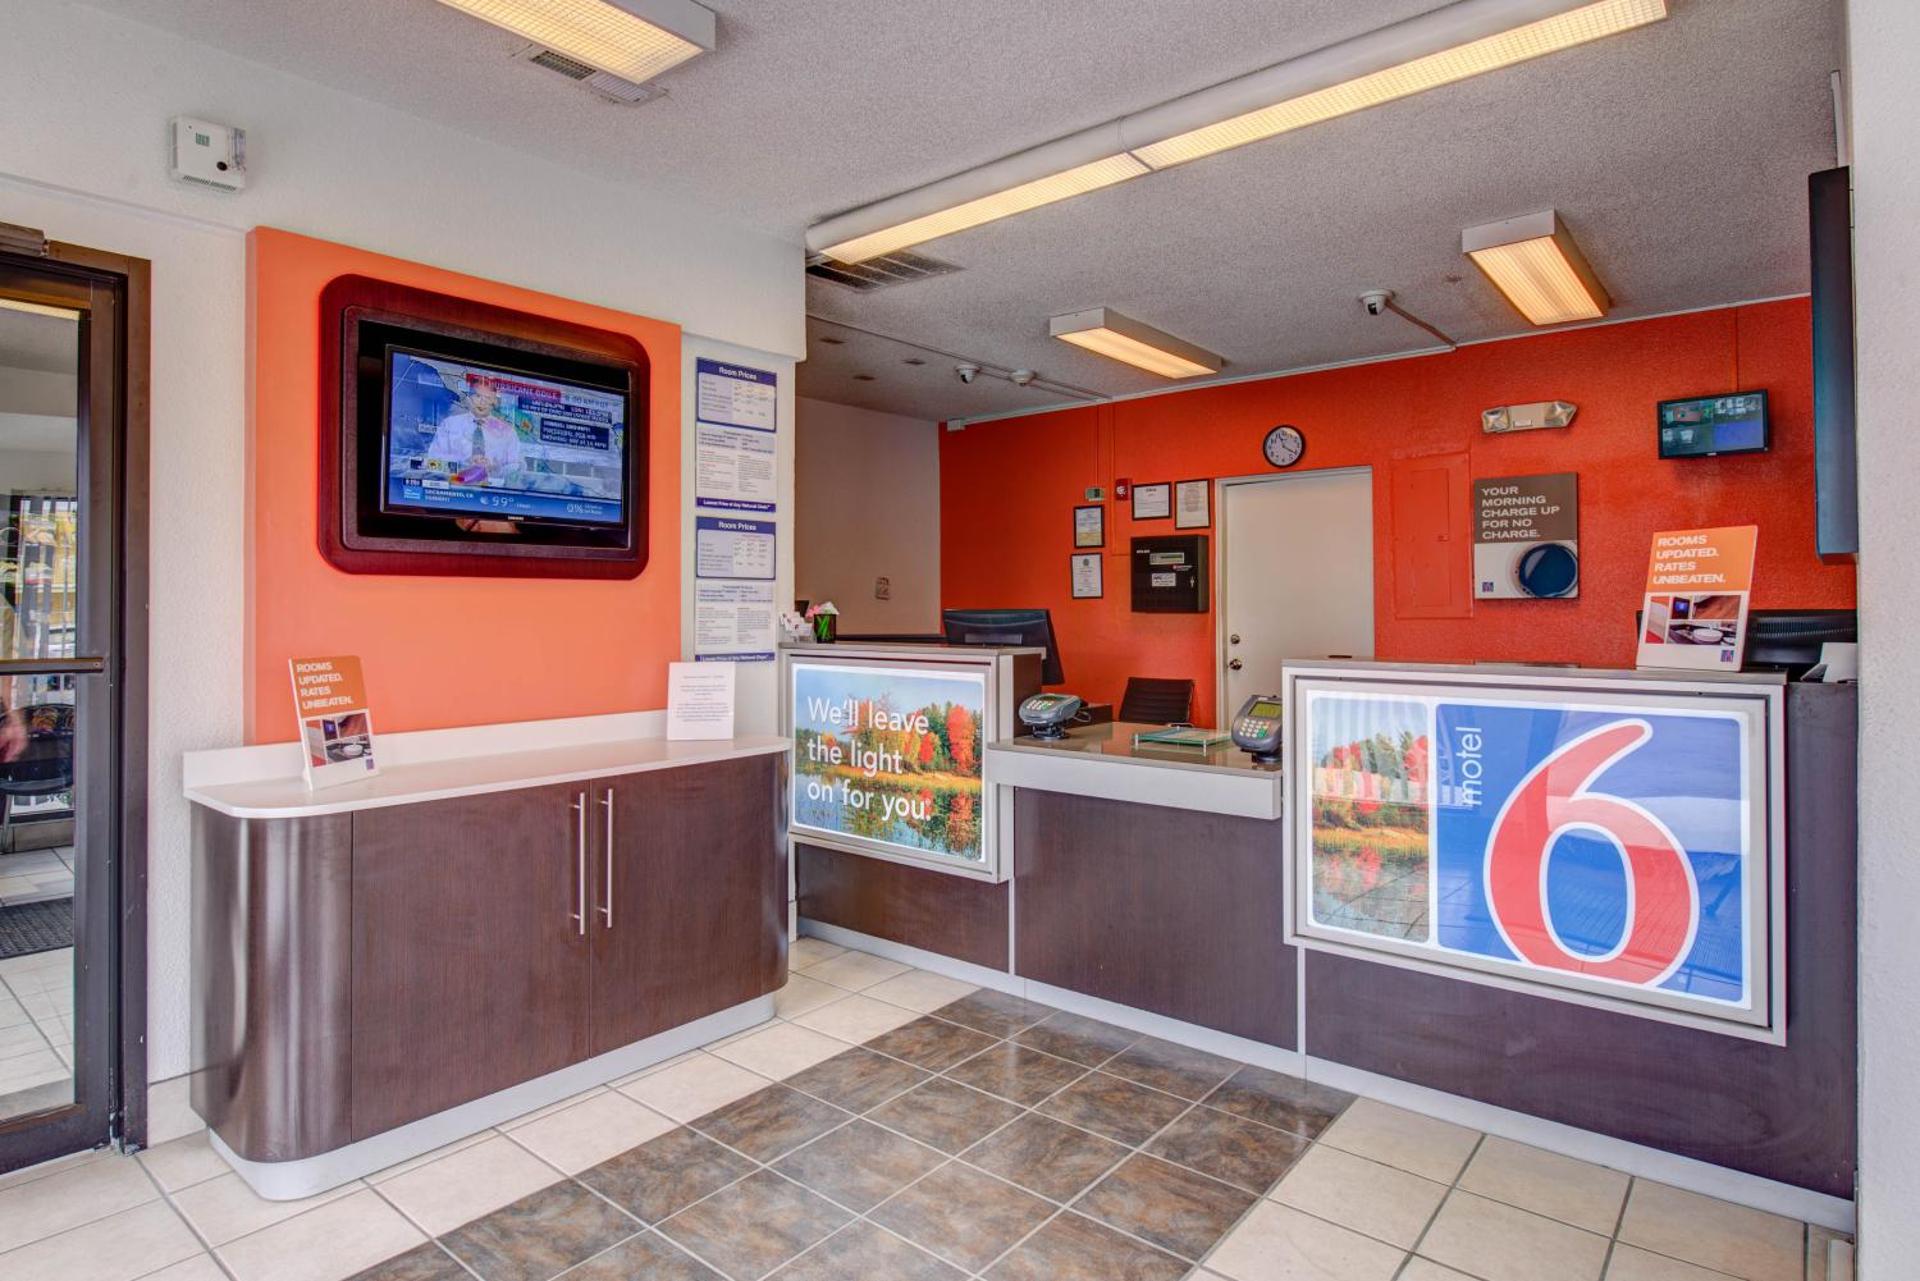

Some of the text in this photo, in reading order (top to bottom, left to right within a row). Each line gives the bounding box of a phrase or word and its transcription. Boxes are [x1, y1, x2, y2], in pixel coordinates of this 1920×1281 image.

[1481, 485, 1519, 496] YOUR
[1481, 495, 1546, 506] MORNING
[1481, 505, 1560, 517] CHARGE UP
[1481, 518, 1533, 529] FOR NO
[1481, 529, 1541, 540] CHARGE.
[1657, 535, 1708, 546] ROOMS
[1656, 547, 1719, 559] UPDATED.
[1655, 560, 1697, 572] RATES
[1653, 573, 1726, 585] UNBEATEN.
[296, 662, 333, 673] ROOMS
[299, 674, 343, 685] UPDATED.
[300, 686, 331, 697] RATES
[302, 696, 354, 710] UNBEATEN.
[808, 696, 929, 735] We'll leave
[808, 735, 902, 778] the light
[1455, 726, 1483, 807] motel
[808, 782, 833, 802] on
[841, 779, 874, 810] for
[1483, 718, 1701, 988] 6
